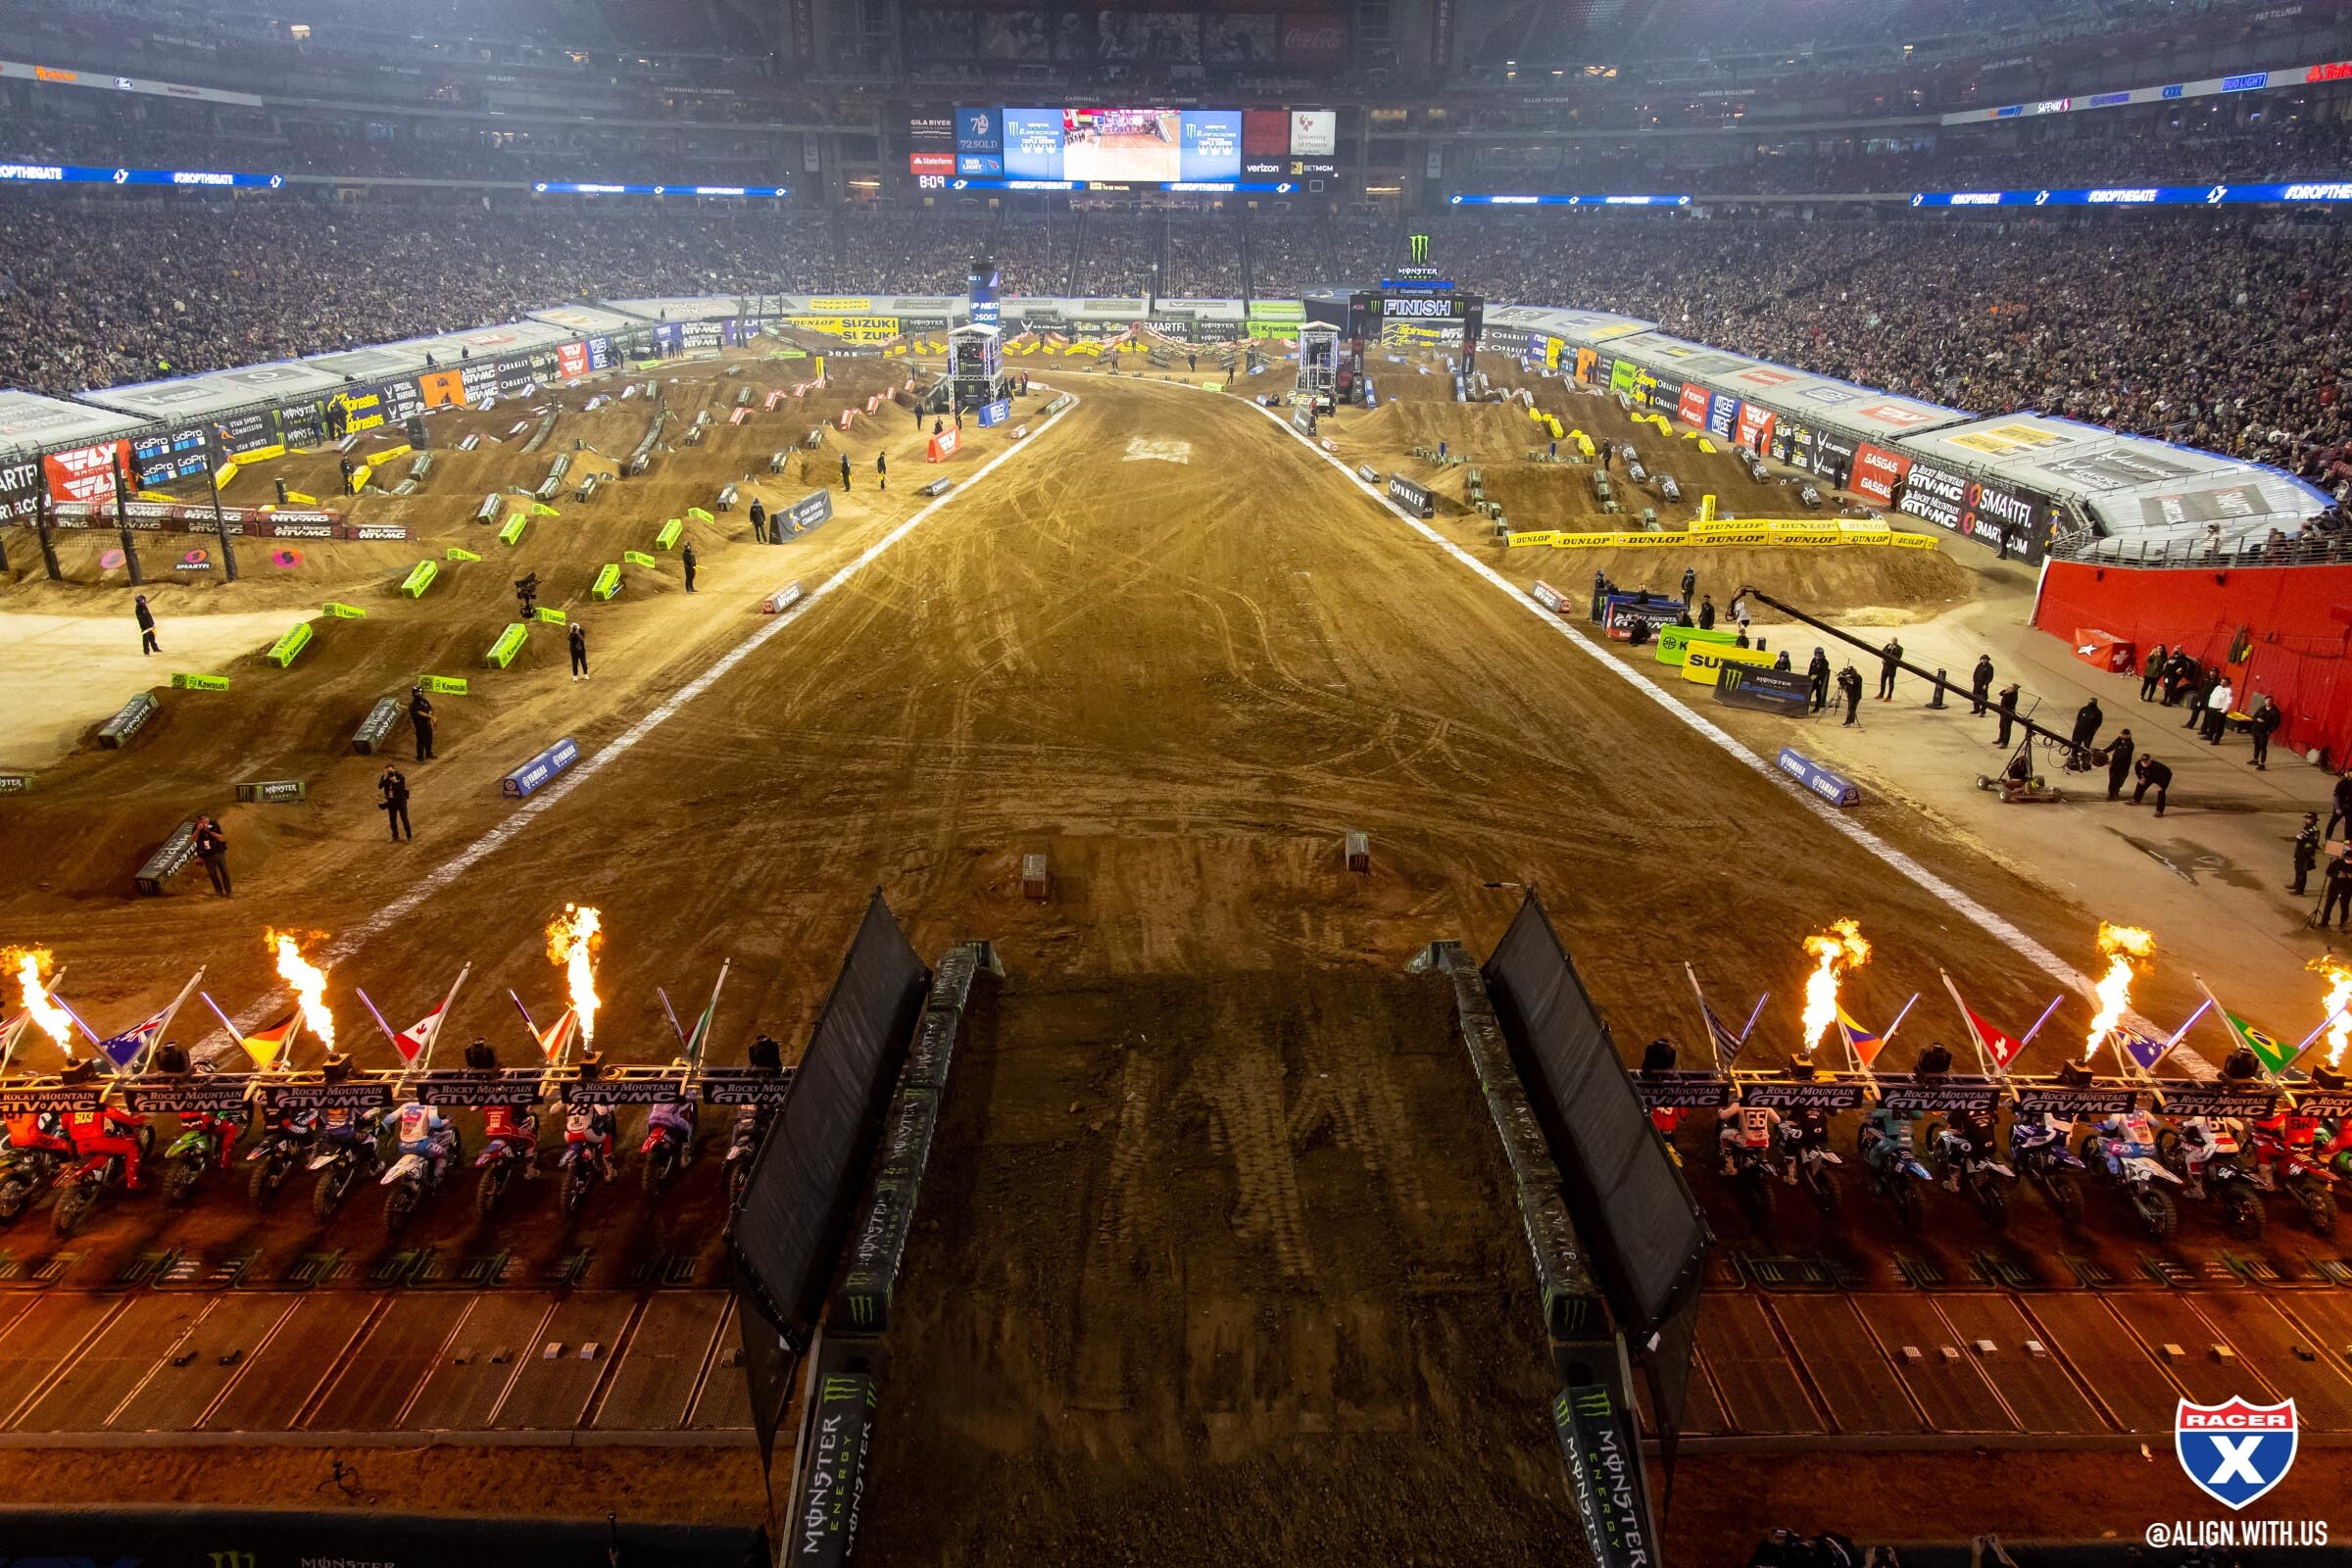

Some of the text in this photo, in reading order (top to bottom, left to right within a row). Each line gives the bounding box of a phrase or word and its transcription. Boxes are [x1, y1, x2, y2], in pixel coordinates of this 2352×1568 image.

[2224, 75, 2264, 89] BUD LIGHT
[2162, 85, 2182, 99] COX
[2037, 100, 2063, 113] SAFEWAY
[1247, 164, 1279, 172] verizon
[174, 172, 233, 184] #DROPTHEGATE
[920, 175, 945, 188] 8:09
[1951, 193, 1999, 204] #DROPTHEGATE
[2088, 189, 2156, 204] #DROPTHEGATE
[1384, 299, 1450, 316] FINISH
[842, 318, 896, 328] SUZUKI
[1492, 331, 1529, 341] OAKLEY
[394, 380, 413, 392] SPECIAL
[282, 404, 317, 418] MONSTER
[232, 422, 264, 436] COMMISSION
[134, 428, 203, 450] GoPro GoPro
[1864, 453, 1898, 472] GASGAS
[1918, 465, 1966, 488] ROCKY MOUNTAIN
[1390, 479, 1425, 508] OAKLEY
[1912, 491, 1960, 514] ROCKY MOUNTAIN
[1563, 536, 1611, 545] DUNLOP
[197, 679, 228, 690] Kawasaki
[1756, 676, 1791, 687] MONSTER
[1787, 758, 1806, 776] YAMAHA
[1819, 779, 1840, 798] YAMAHA
[292, 1087, 383, 1097] ROCKY MOUNTAIN
[442, 1085, 532, 1094] ROCKY MOUNTAIN
[585, 1083, 675, 1092] ROCKY MOUNTAIN
[1667, 1087, 1722, 1096] MOUNTAIN
[1766, 1086, 1855, 1096] ROCKY MOUNTAIN
[38, 1092, 95, 1101] MOUNTAIN
[150, 1090, 244, 1100] ROCKY MOUNTAIN
[1904, 1090, 1993, 1100] ROCKY MOUNTAIN
[2039, 1092, 2129, 1102] ROCKY MOUNTAIN
[2216, 1097, 2269, 1105] MOUNTAIN
[74, 1112, 94, 1125] 503
[804, 1414, 842, 1554] MONSTER
[831, 1435, 853, 1531] ENERGY
[846, 1421, 871, 1557] MONSTER
[1590, 1452, 1619, 1548] ENERGY
[1599, 1430, 1647, 1568] MONSTER
